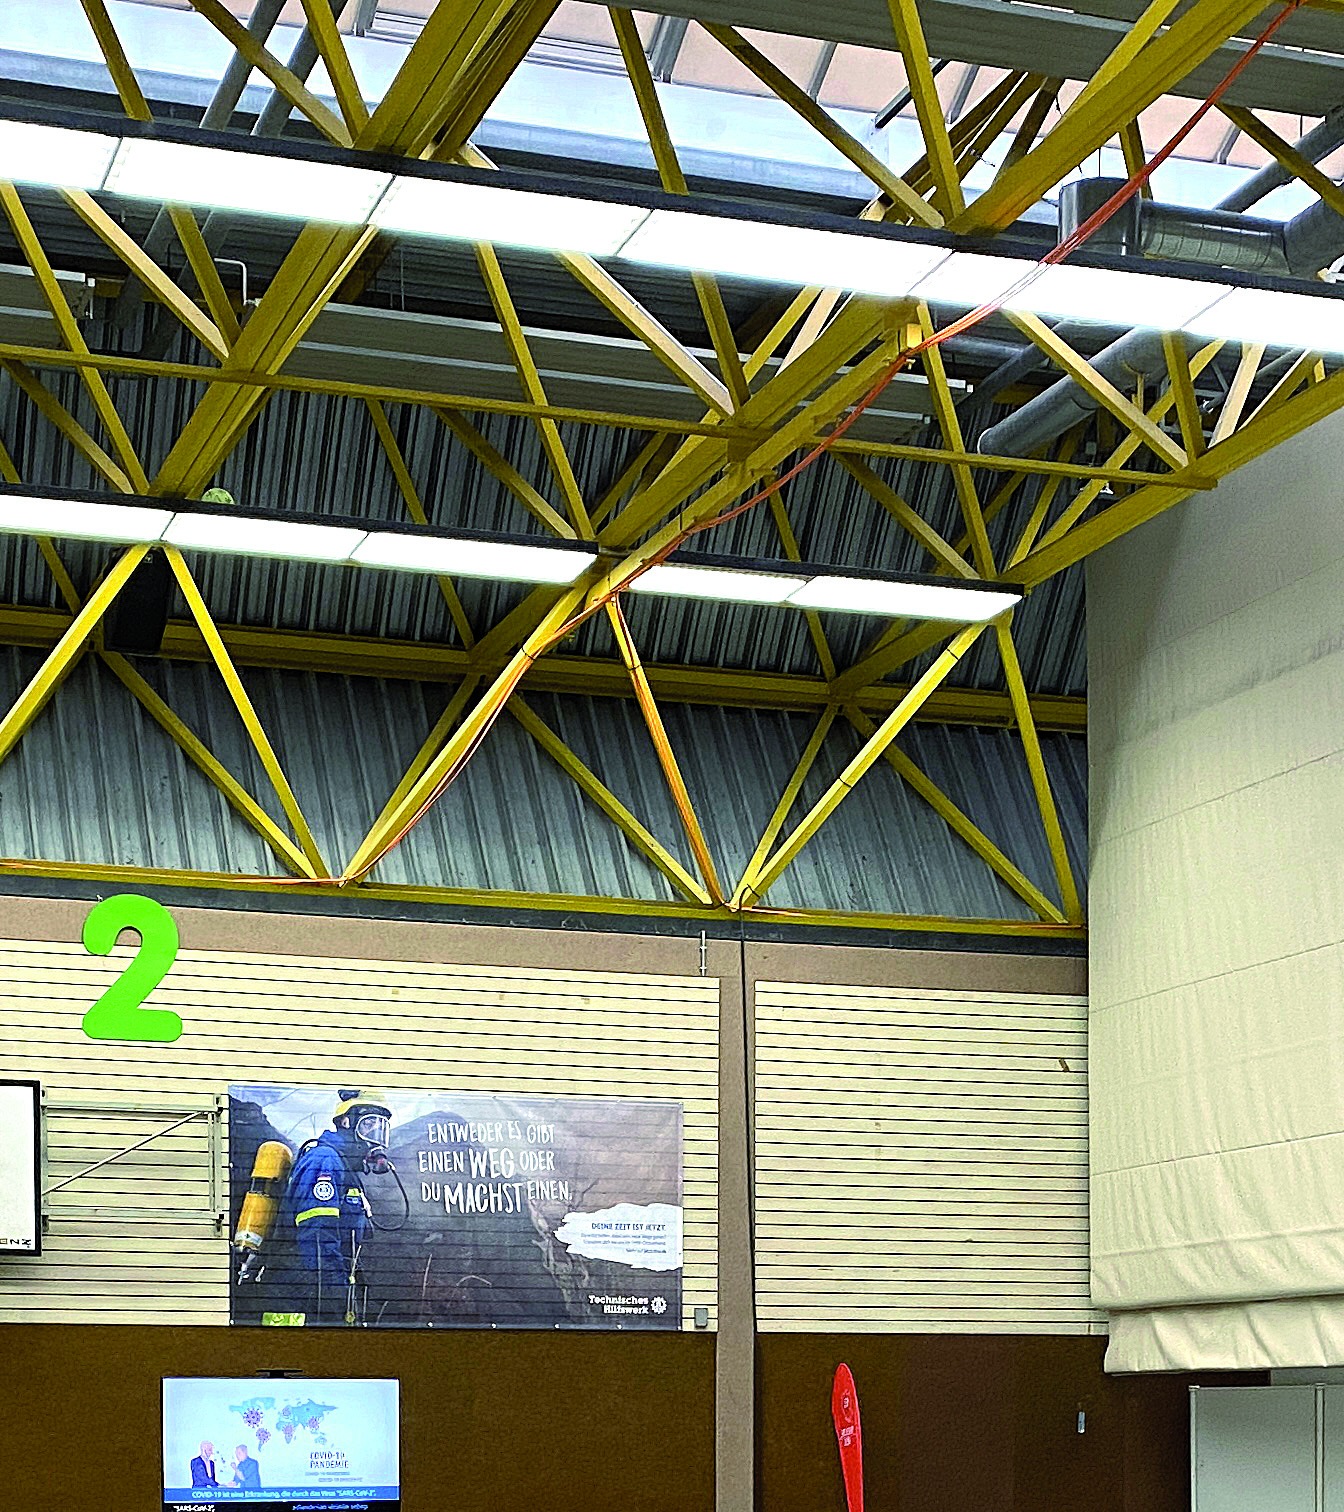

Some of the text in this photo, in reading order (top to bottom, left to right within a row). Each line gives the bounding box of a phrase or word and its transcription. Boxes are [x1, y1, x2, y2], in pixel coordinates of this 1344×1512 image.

[82, 893, 183, 1043] 2
[428, 1120, 555, 1144] ENTWEDER ES GIBT
[417, 1147, 555, 1179] EINEN WEG ODER
[421, 1181, 441, 1202] DU
[443, 1181, 524, 1214] MACHST
[588, 1294, 649, 1305] Technisches
[603, 1305, 649, 1315] Hilfswerk
